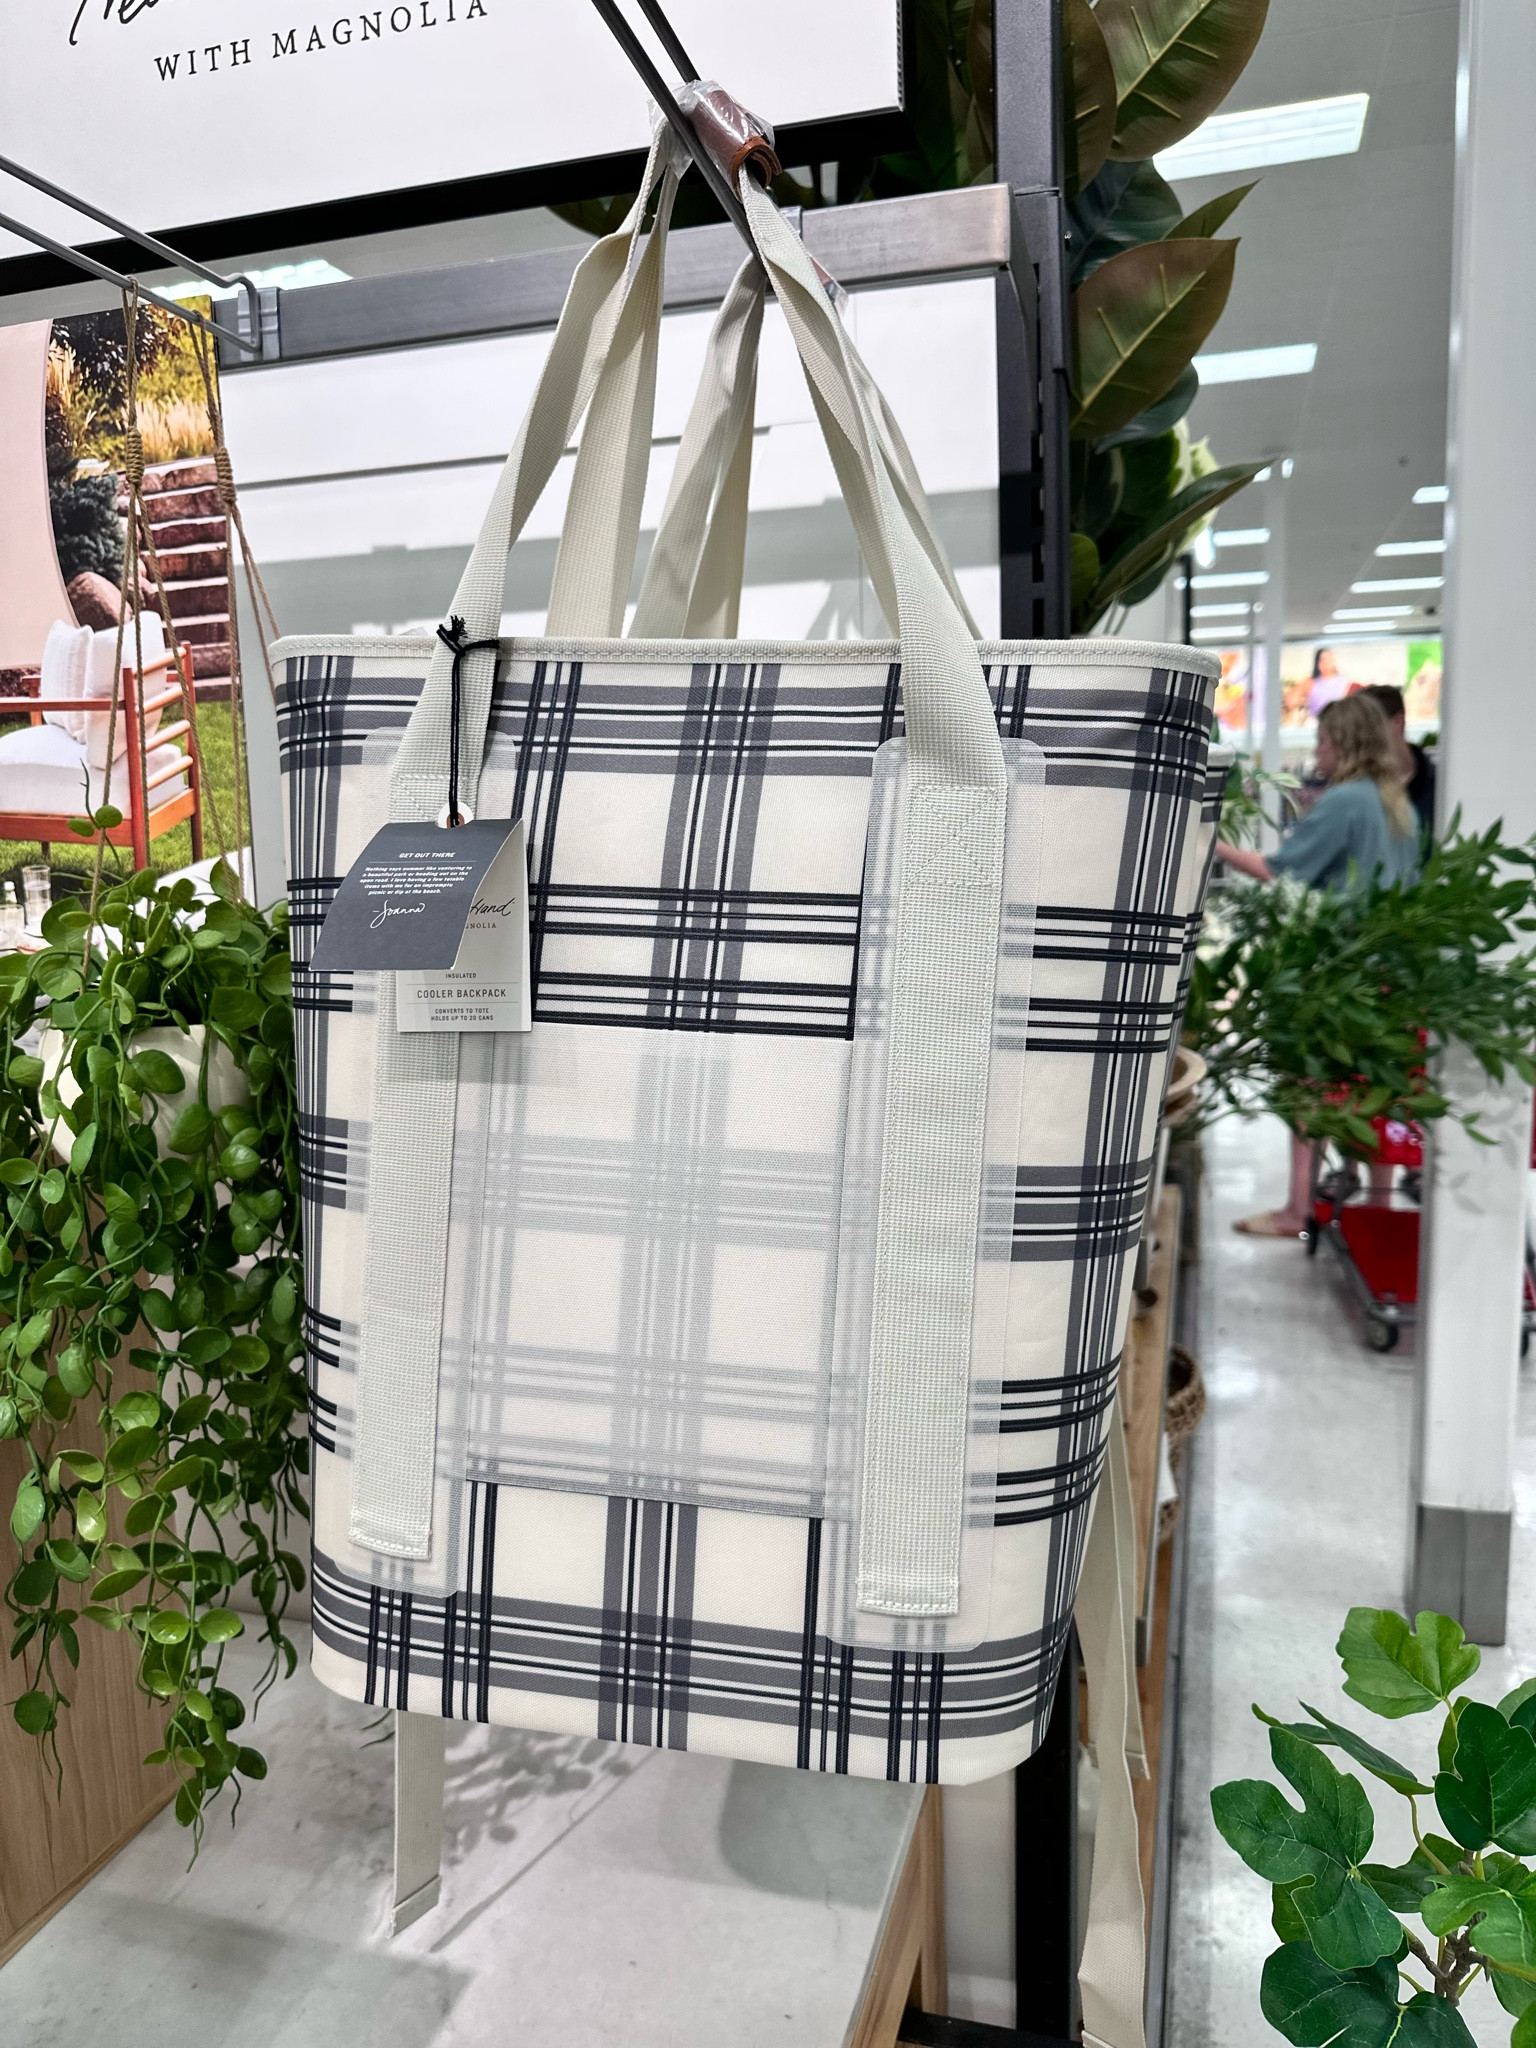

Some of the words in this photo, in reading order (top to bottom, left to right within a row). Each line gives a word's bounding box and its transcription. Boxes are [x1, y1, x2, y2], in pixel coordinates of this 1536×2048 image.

[153, 39, 252, 82] WITH
[272, 0, 488, 58] MAGNOLIA
[417, 989, 453, 998] COOLER
[457, 988, 507, 998] BACKPACK
